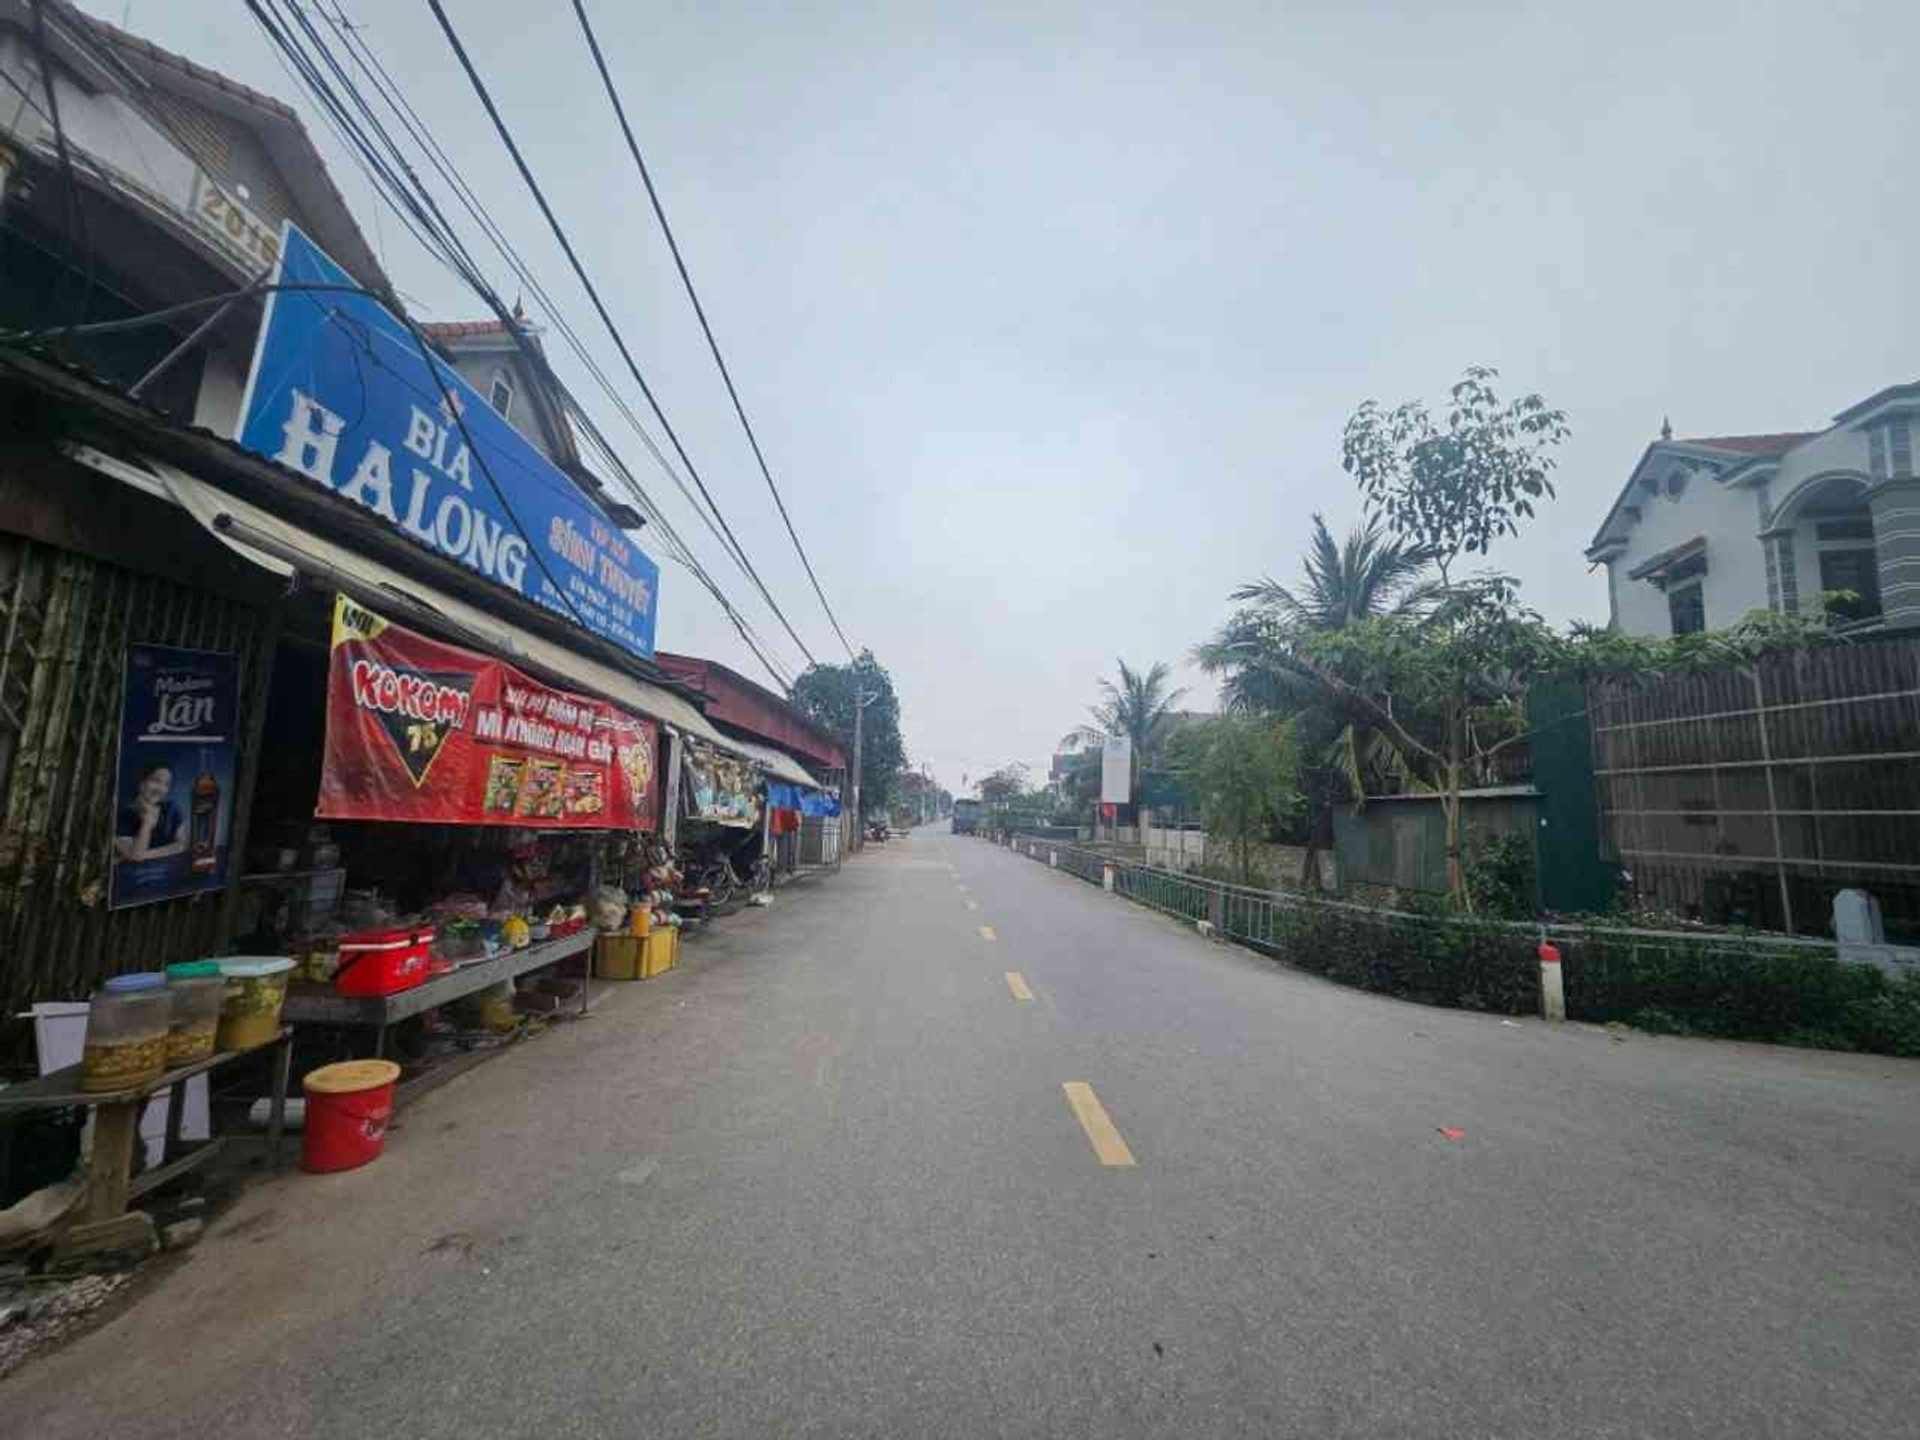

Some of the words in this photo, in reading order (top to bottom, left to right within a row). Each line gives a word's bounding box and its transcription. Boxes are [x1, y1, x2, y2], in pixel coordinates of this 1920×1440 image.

[273, 387, 528, 594] HALONG
[403, 404, 473, 492] BIA
[353, 659, 469, 729] KOKOMI
